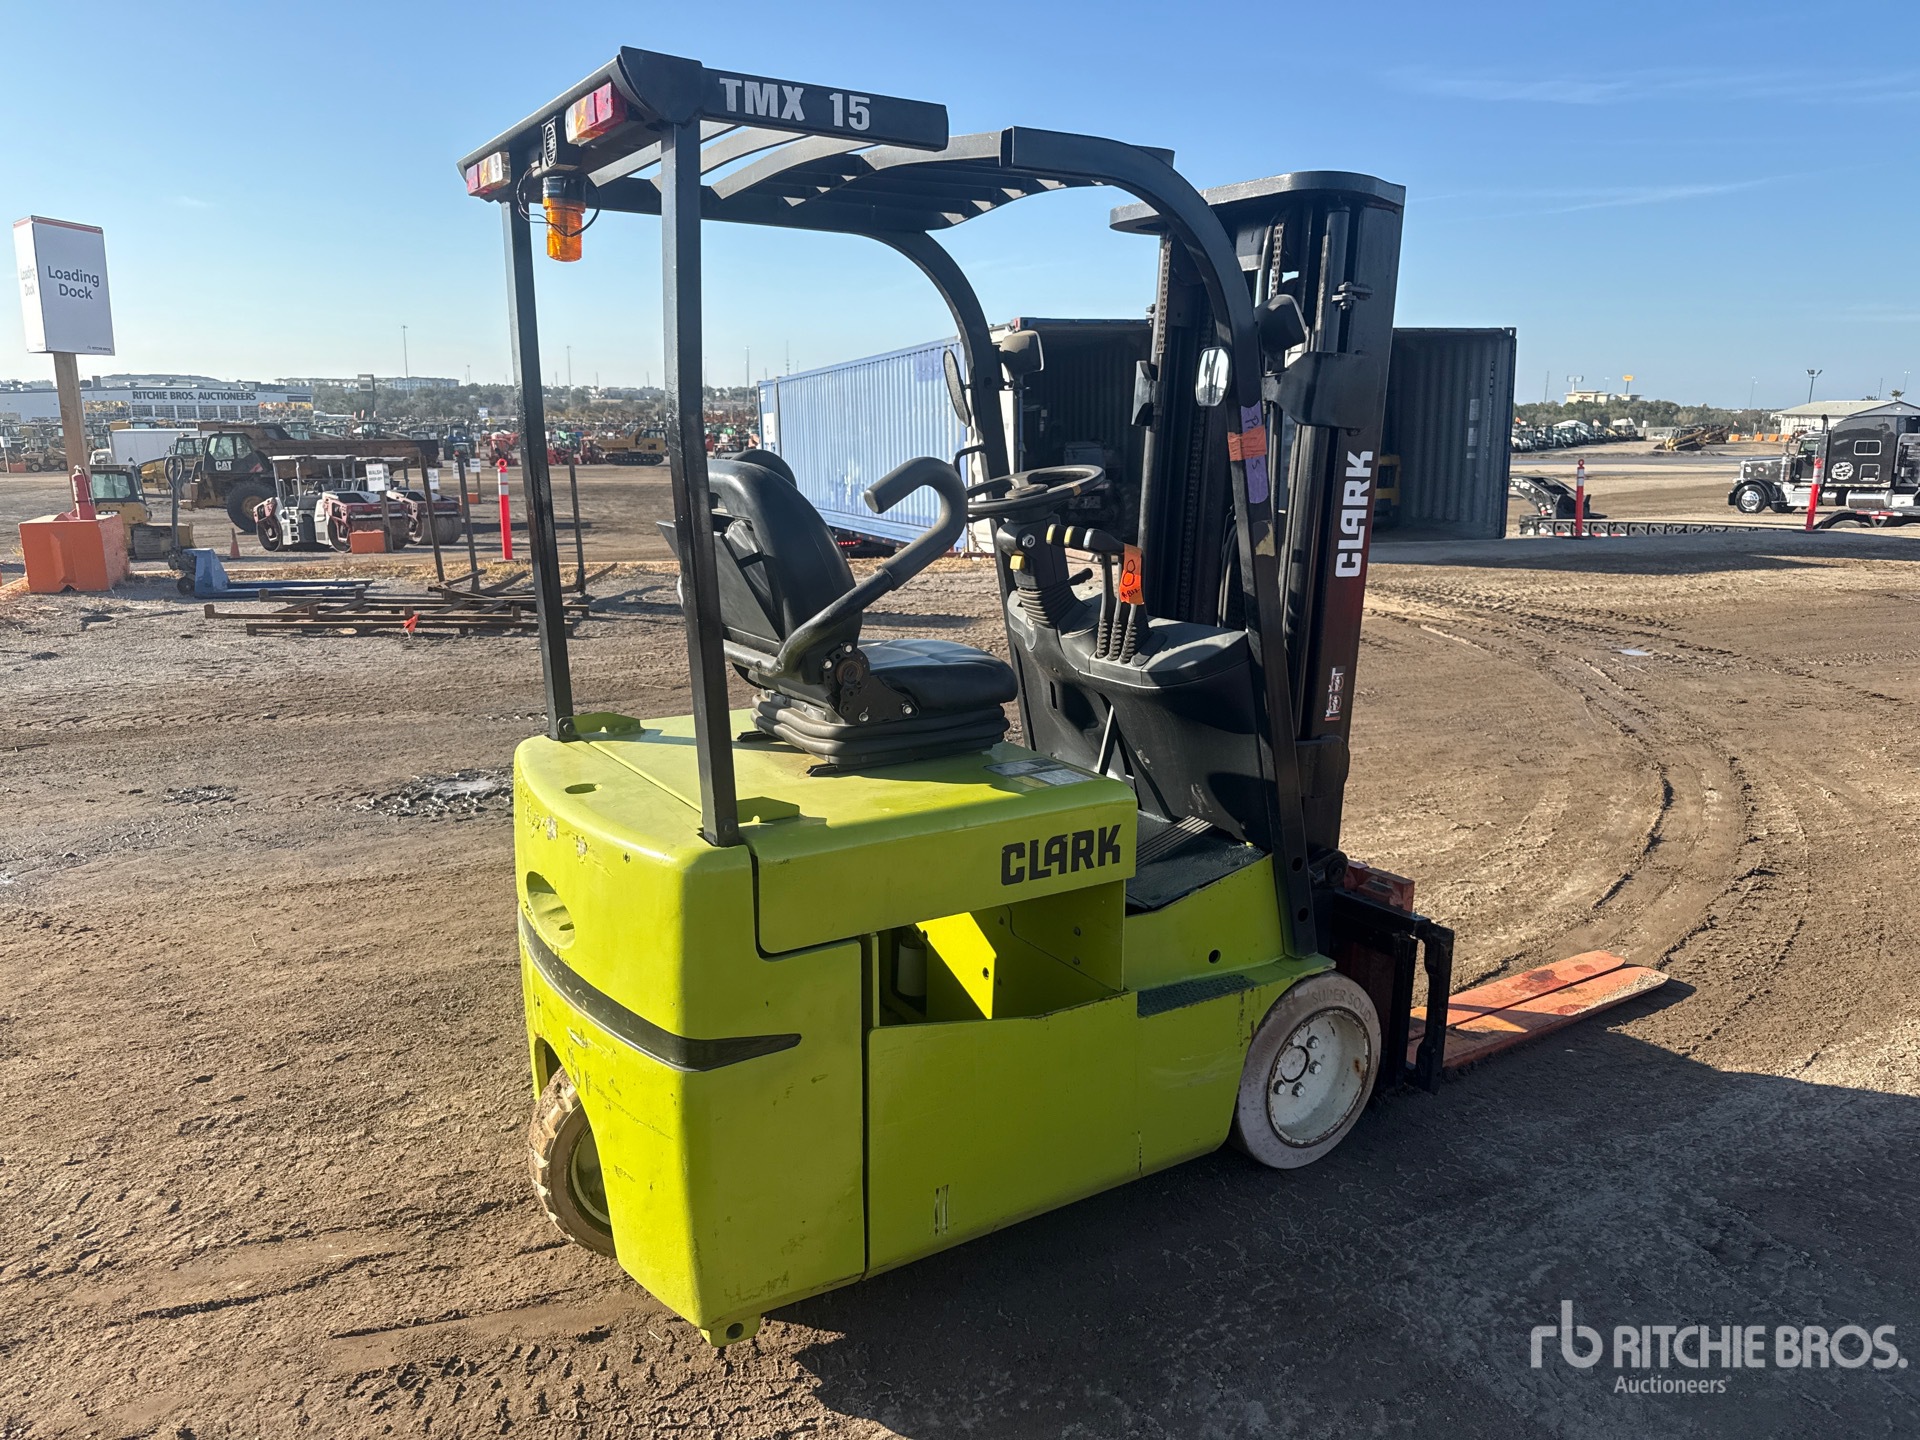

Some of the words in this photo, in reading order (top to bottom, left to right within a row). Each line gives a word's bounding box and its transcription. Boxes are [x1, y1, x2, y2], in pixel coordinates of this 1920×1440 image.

[719, 77, 805, 122] TMX
[829, 92, 871, 131] 15
[47, 265, 100, 288] Loading
[58, 283, 93, 300] Dock
[132, 391, 168, 400] RITCHIE
[170, 391, 196, 401] BROS.
[197, 391, 257, 401] AUCTIONEERS
[215, 460, 233, 472] CAT
[1335, 450, 1373, 578] CLARK
[1001, 824, 1122, 886] CLARK
[1311, 988, 1346, 1006] SUPER
[1347, 992, 1372, 1023] SOLID
